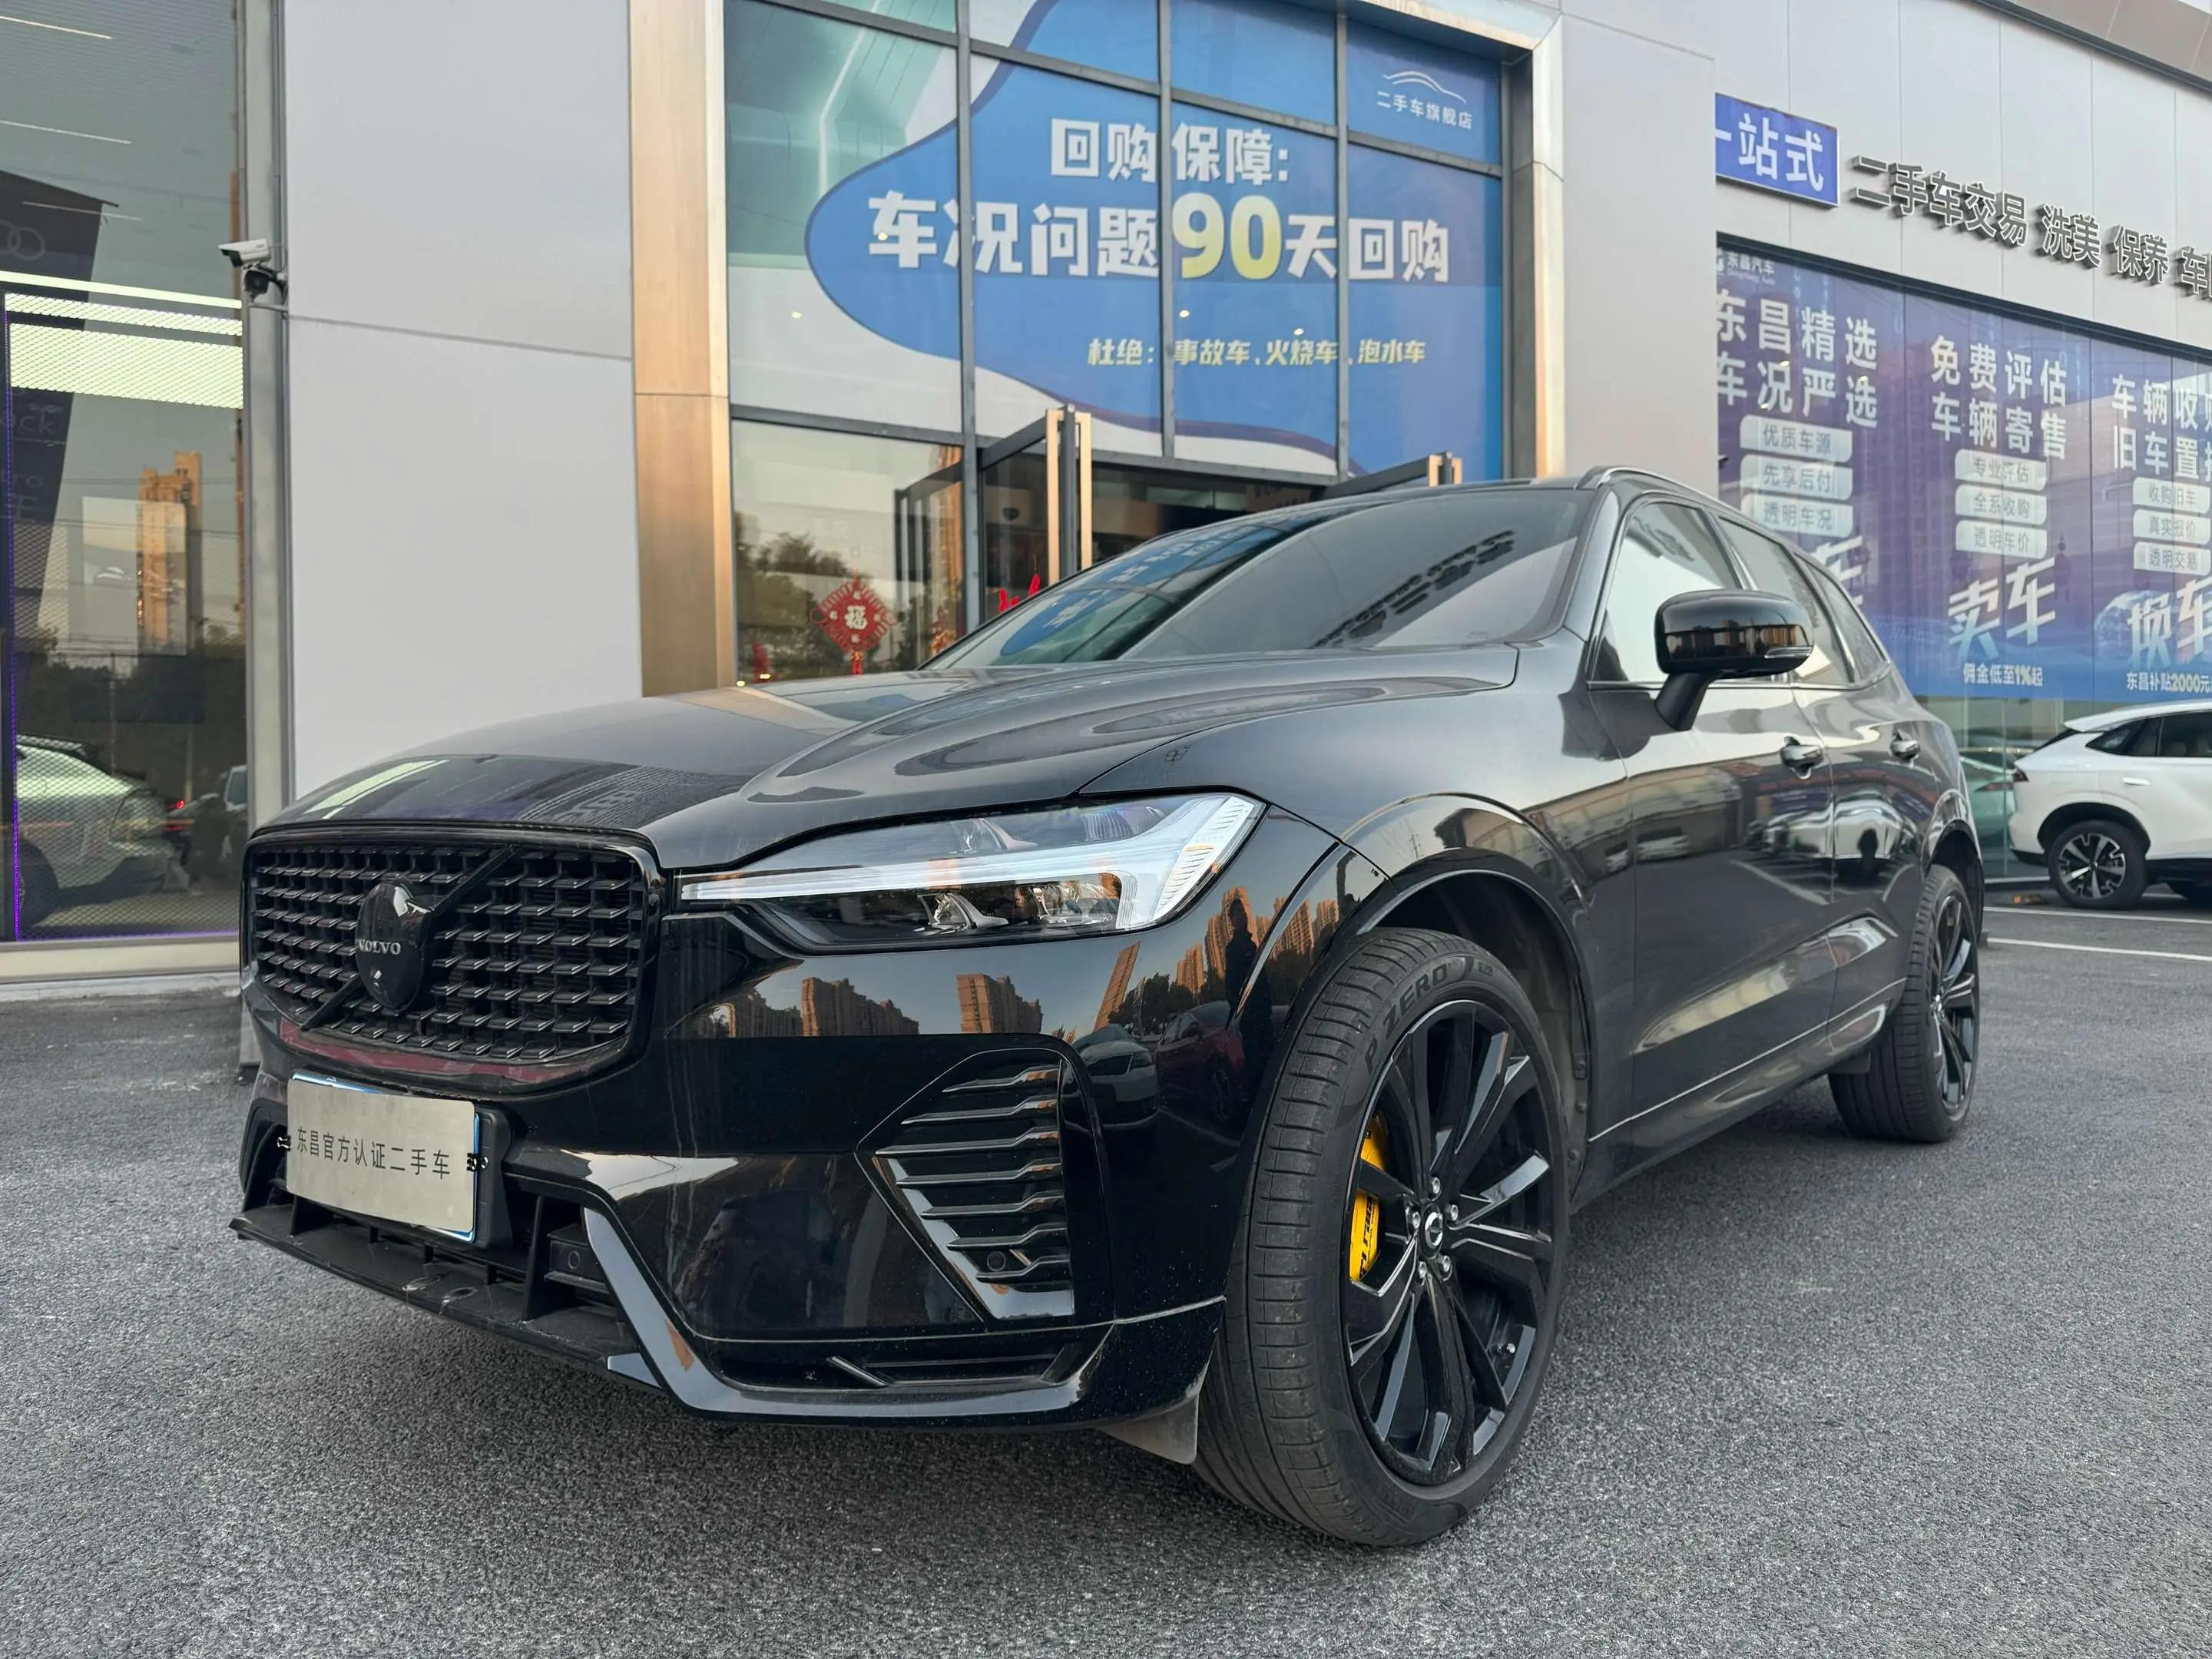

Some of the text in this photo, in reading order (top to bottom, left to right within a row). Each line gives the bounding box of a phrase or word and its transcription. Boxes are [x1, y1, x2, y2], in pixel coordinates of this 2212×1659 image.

[1376, 90, 1472, 130] 二手车旗舰店
[867, 189, 1450, 283] 车况问题90天回购
[1853, 155, 2212, 298] 二手车交易 洗美 保养 车
[1717, 289, 1877, 371] 东昌精选
[1931, 335, 2066, 407] 免费评估
[1717, 352, 1878, 428] 车况严选
[1763, 424, 1831, 455] 优质车源
[1931, 392, 2066, 460] 车辆寄售
[1763, 464, 1831, 492] 先享后付
[1974, 457, 2029, 483] 专业评估
[1974, 492, 2029, 518] 全系收购
[2149, 485, 2196, 505] 收购旧车
[1764, 502, 1833, 530] 透明车况
[2149, 516, 2197, 539] 真实报价
[1974, 525, 2029, 553] 透明车价
[2150, 548, 2197, 569] 透明交易
[1948, 557, 2056, 661] 卖车
[1963, 662, 2043, 687] 佣金低至1%起
[2126, 671, 2212, 694] 东昌补贴2000元
[357, 939, 401, 955] VOLVO
[1382, 962, 1448, 1041] ZERO
[296, 1126, 451, 1180] 东昌官方认证二手车
